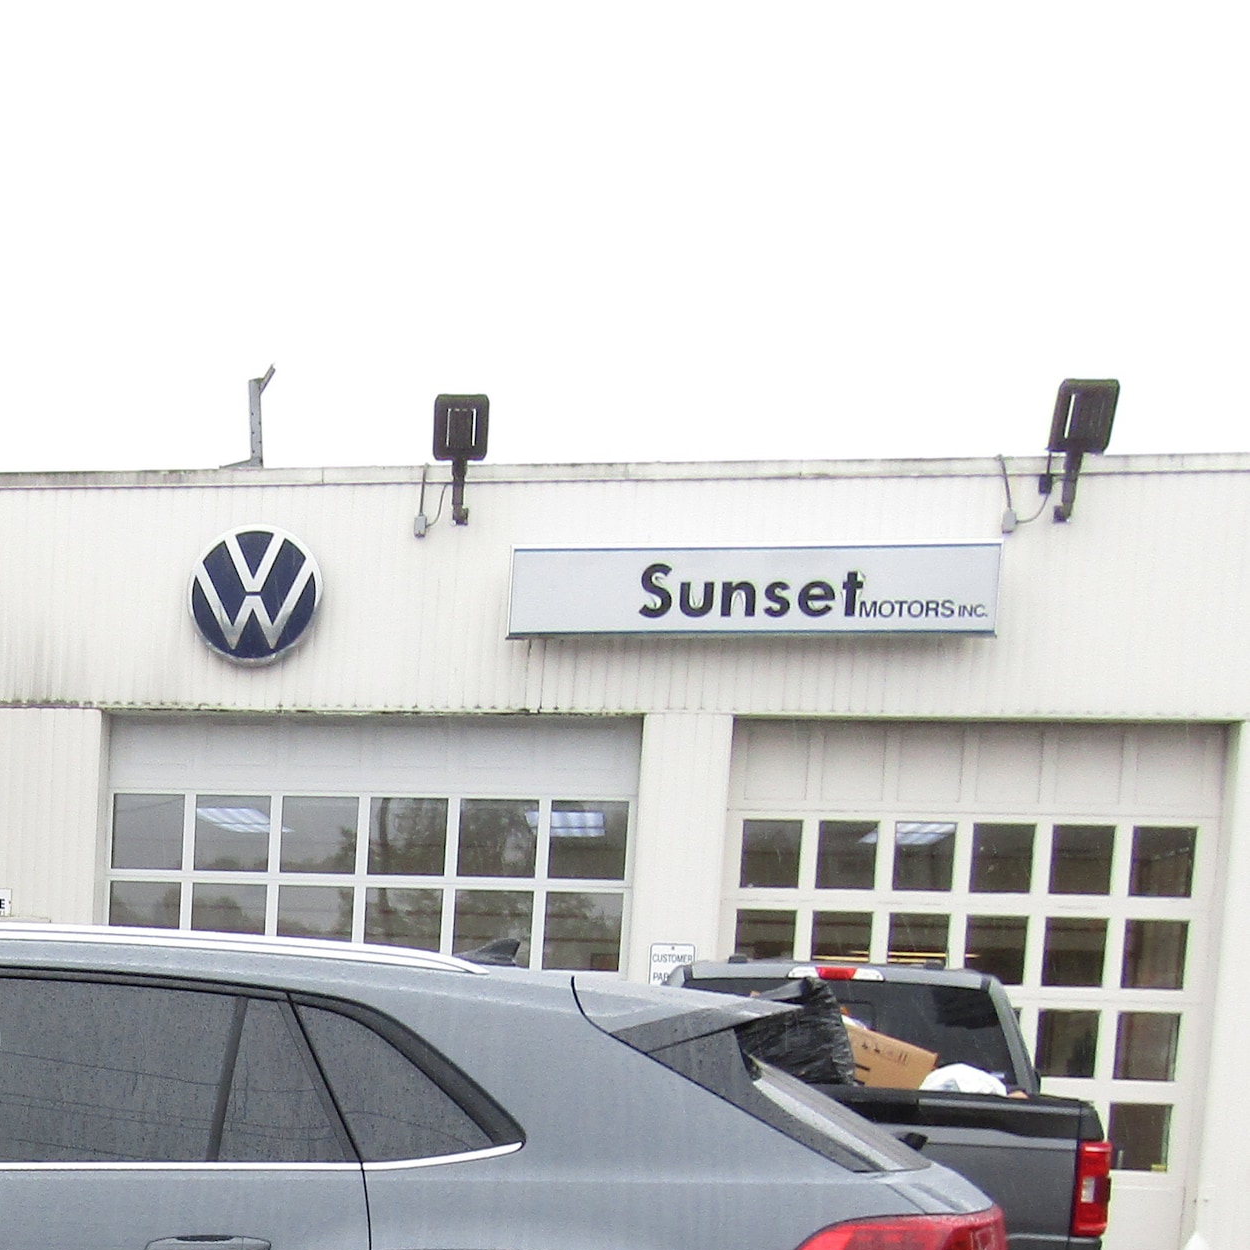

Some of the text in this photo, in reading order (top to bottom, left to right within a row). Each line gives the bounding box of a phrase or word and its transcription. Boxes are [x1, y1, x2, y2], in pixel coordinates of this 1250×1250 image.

[639, 563, 988, 618] Sunset MOTORS INC.
[652, 953, 693, 963] CUSTOMER
